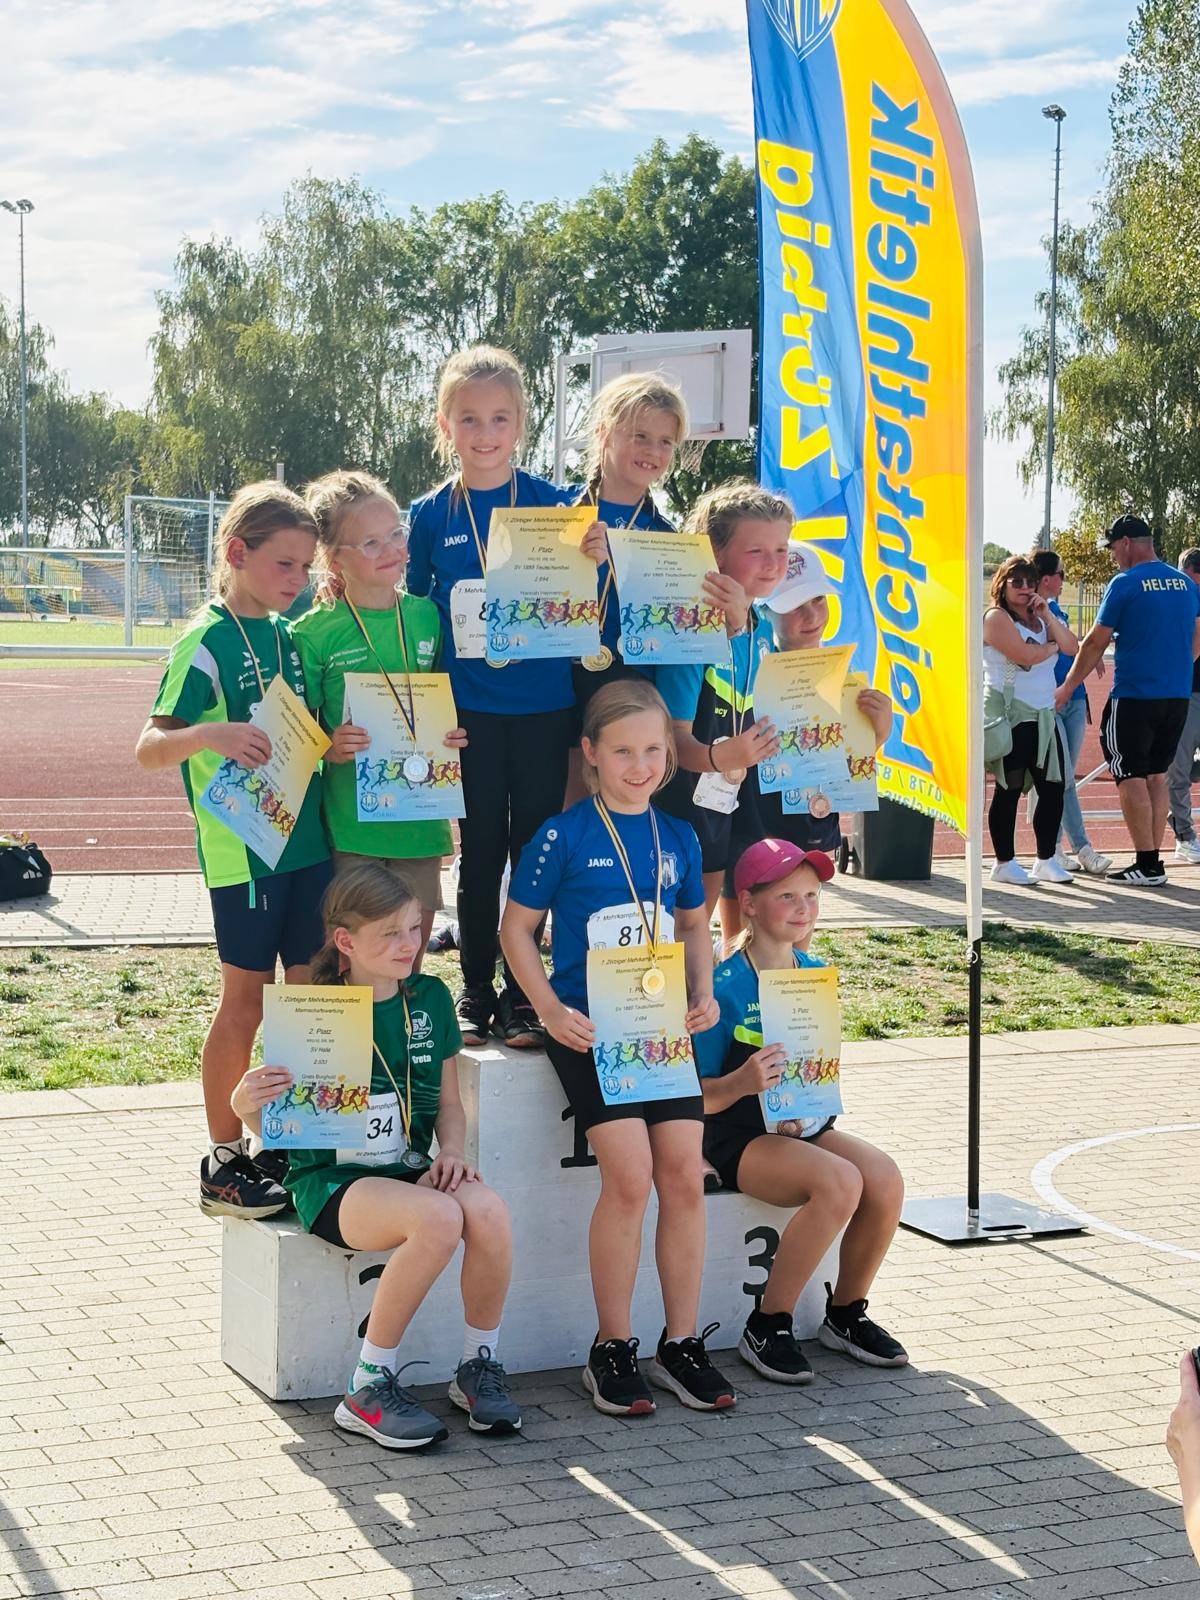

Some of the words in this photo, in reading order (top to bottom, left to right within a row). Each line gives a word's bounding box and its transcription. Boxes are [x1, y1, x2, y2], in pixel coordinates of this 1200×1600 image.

[444, 534, 469, 547] JAKO
[1142, 578, 1188, 592] HELFER
[588, 858, 614, 868] JAKO
[618, 924, 644, 947] 81
[367, 1115, 393, 1140] 34
[742, 1226, 780, 1296] 3
